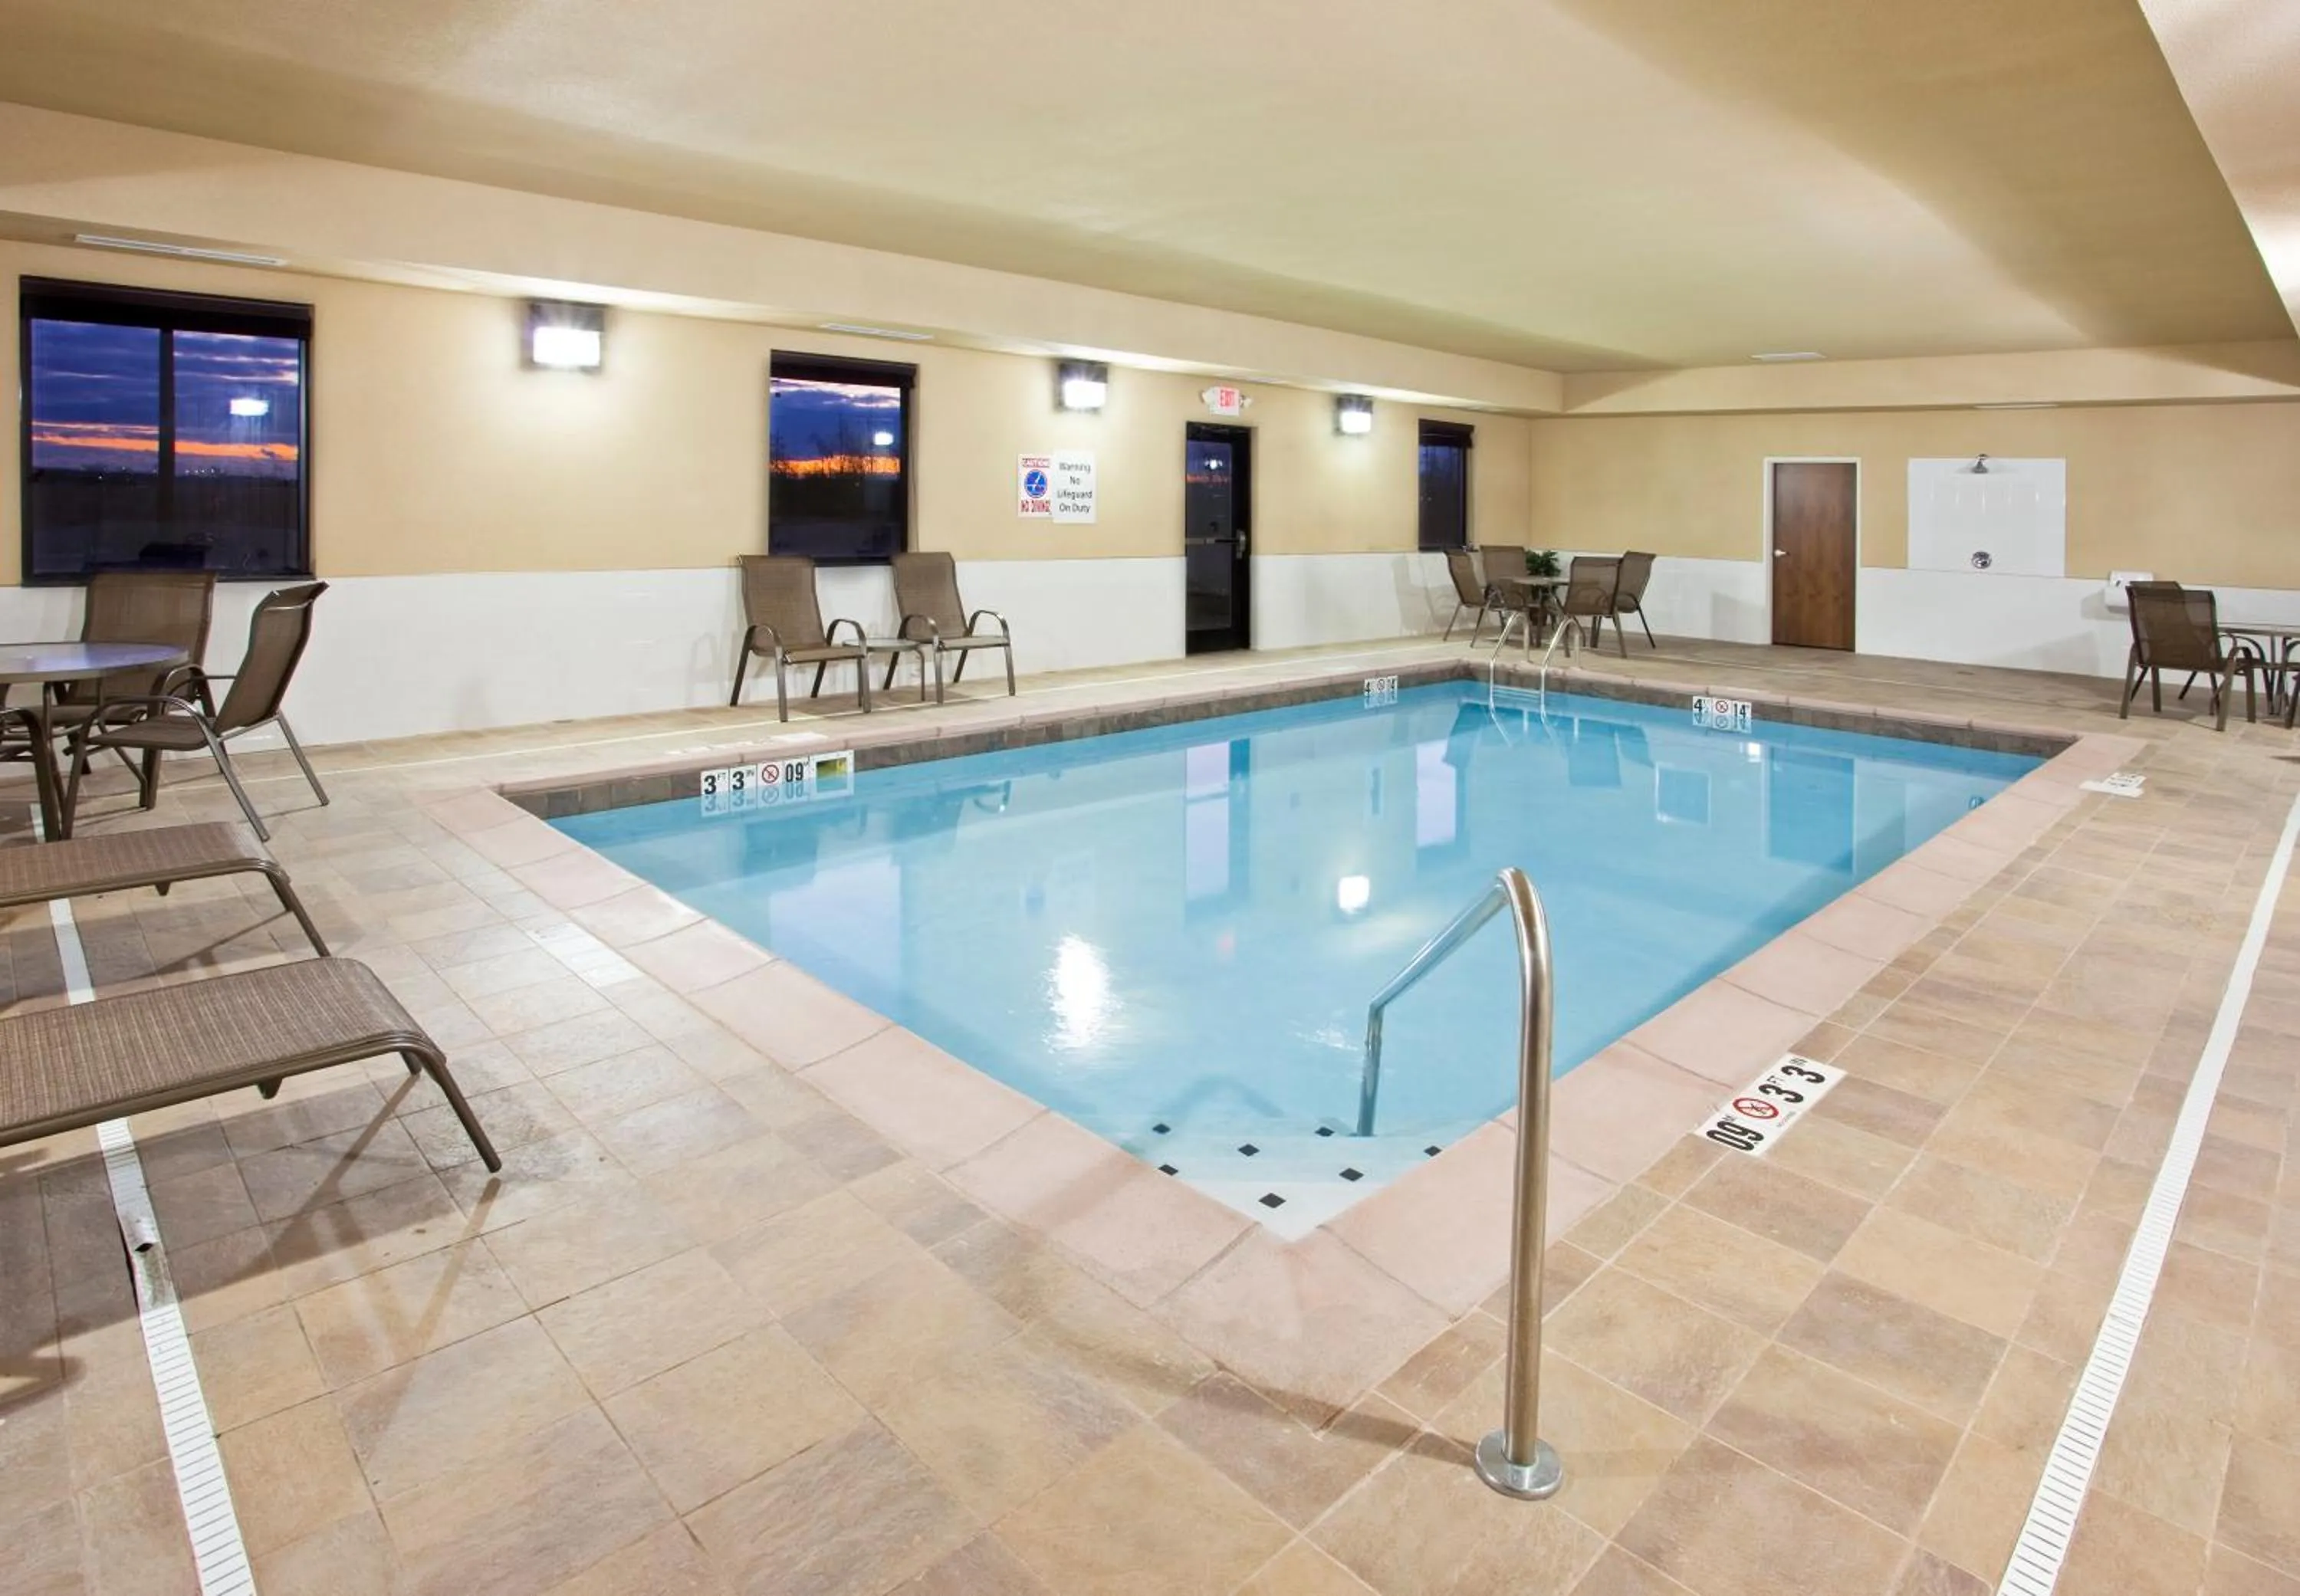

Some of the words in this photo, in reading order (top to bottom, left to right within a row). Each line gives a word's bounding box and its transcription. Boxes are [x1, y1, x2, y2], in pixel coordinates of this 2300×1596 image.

[1059, 462, 1091, 474] Warning
[1070, 476, 1080, 485] No
[1056, 489, 1092, 500] Lifeguard
[1059, 503, 1071, 513] On
[1072, 503, 1091, 514] Duty
